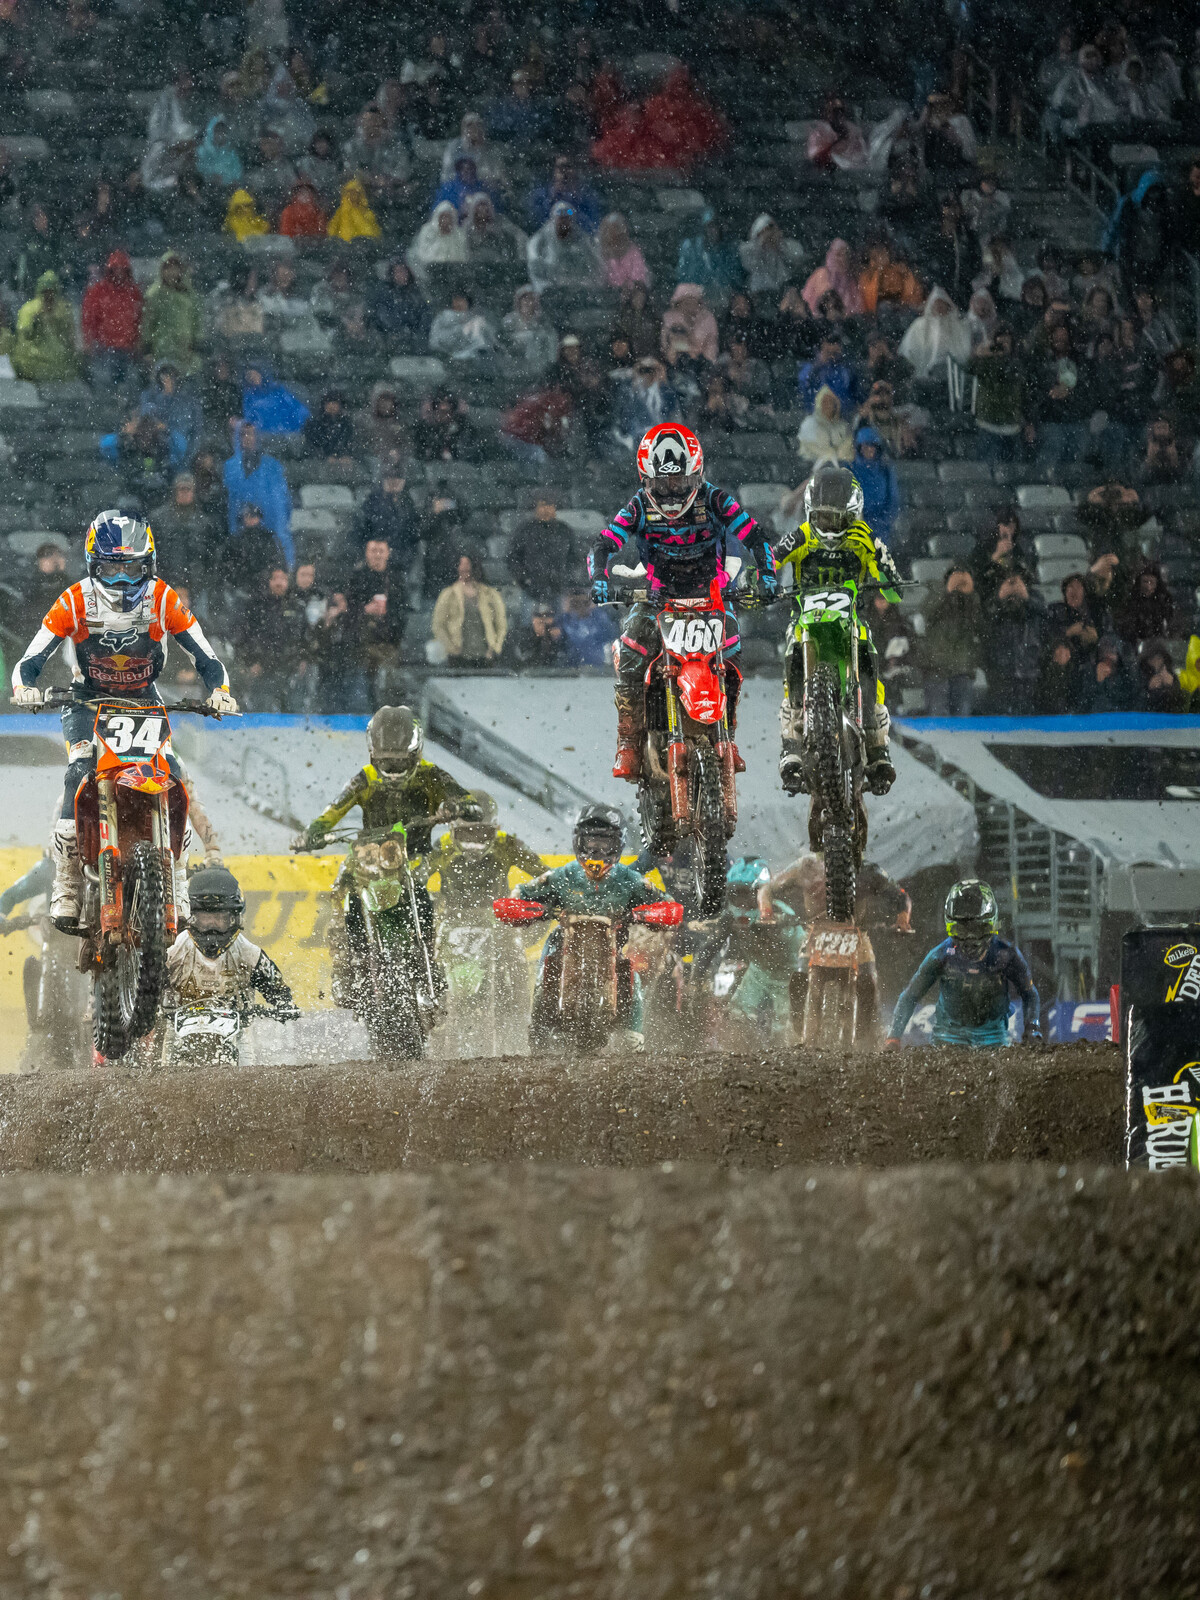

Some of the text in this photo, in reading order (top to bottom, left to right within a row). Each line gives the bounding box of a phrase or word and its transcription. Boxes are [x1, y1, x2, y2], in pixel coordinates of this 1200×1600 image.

[821, 551, 843, 560] FOX
[803, 592, 851, 618] 52
[666, 618, 723, 654] 460
[88, 663, 154, 683] Red Bull
[105, 716, 162, 755] 34
[1167, 947, 1195, 963] mike's
